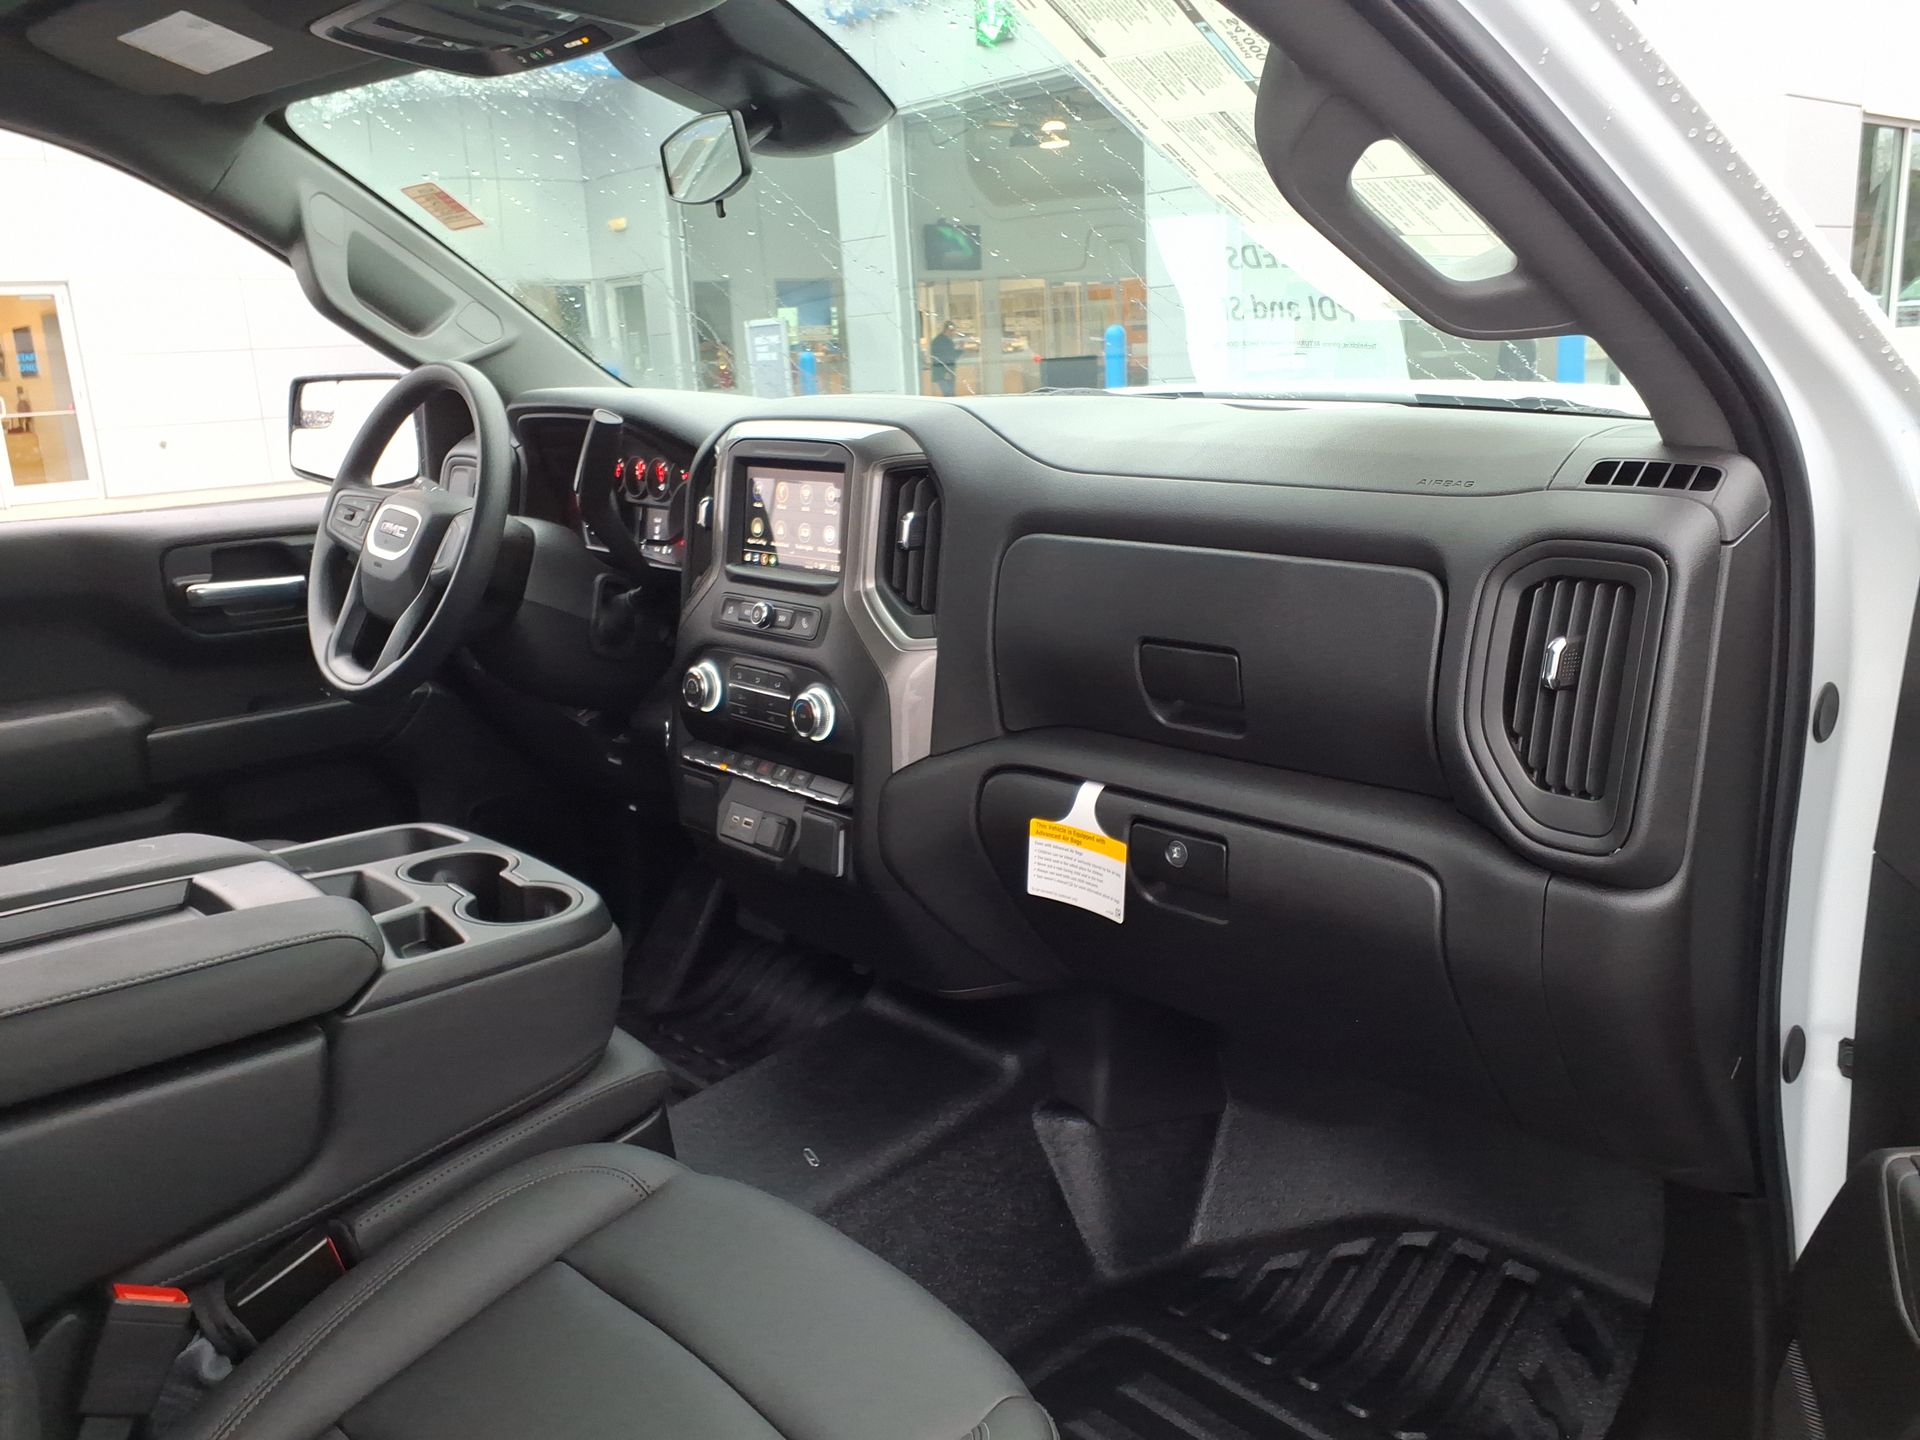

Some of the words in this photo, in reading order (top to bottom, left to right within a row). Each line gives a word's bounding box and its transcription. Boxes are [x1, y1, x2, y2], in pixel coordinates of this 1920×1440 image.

[1416, 478, 1475, 488] AIRBAG
[380, 520, 408, 539] GMC
[1035, 830, 1061, 840] Advanced
[1073, 829, 1096, 841] Equipped
